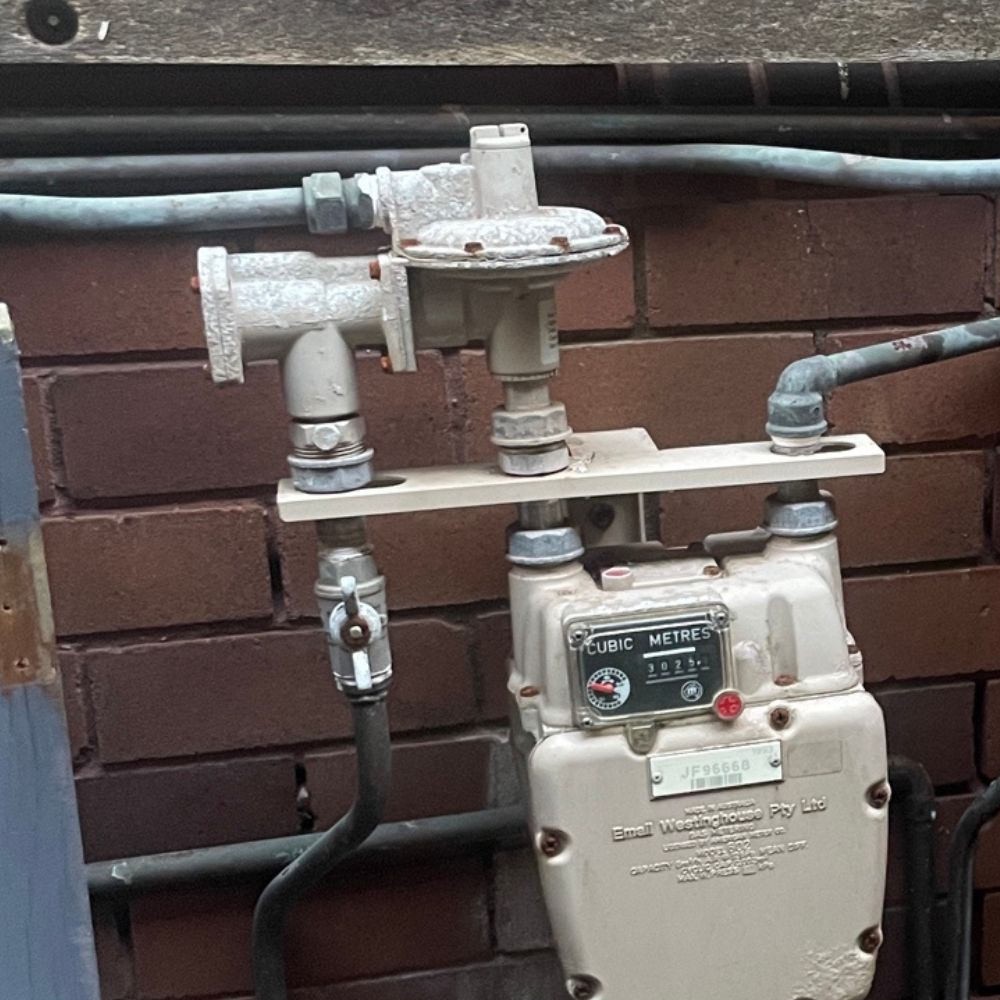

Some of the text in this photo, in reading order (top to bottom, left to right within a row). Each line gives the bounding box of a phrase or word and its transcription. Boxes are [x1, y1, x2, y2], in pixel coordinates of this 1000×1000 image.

[587, 627, 711, 655] CUBIC METRES
[612, 822, 653, 842] Email
[659, 808, 763, 834] Westinghouse
[769, 802, 796, 819] Pty
[801, 797, 828, 814] Ltd
